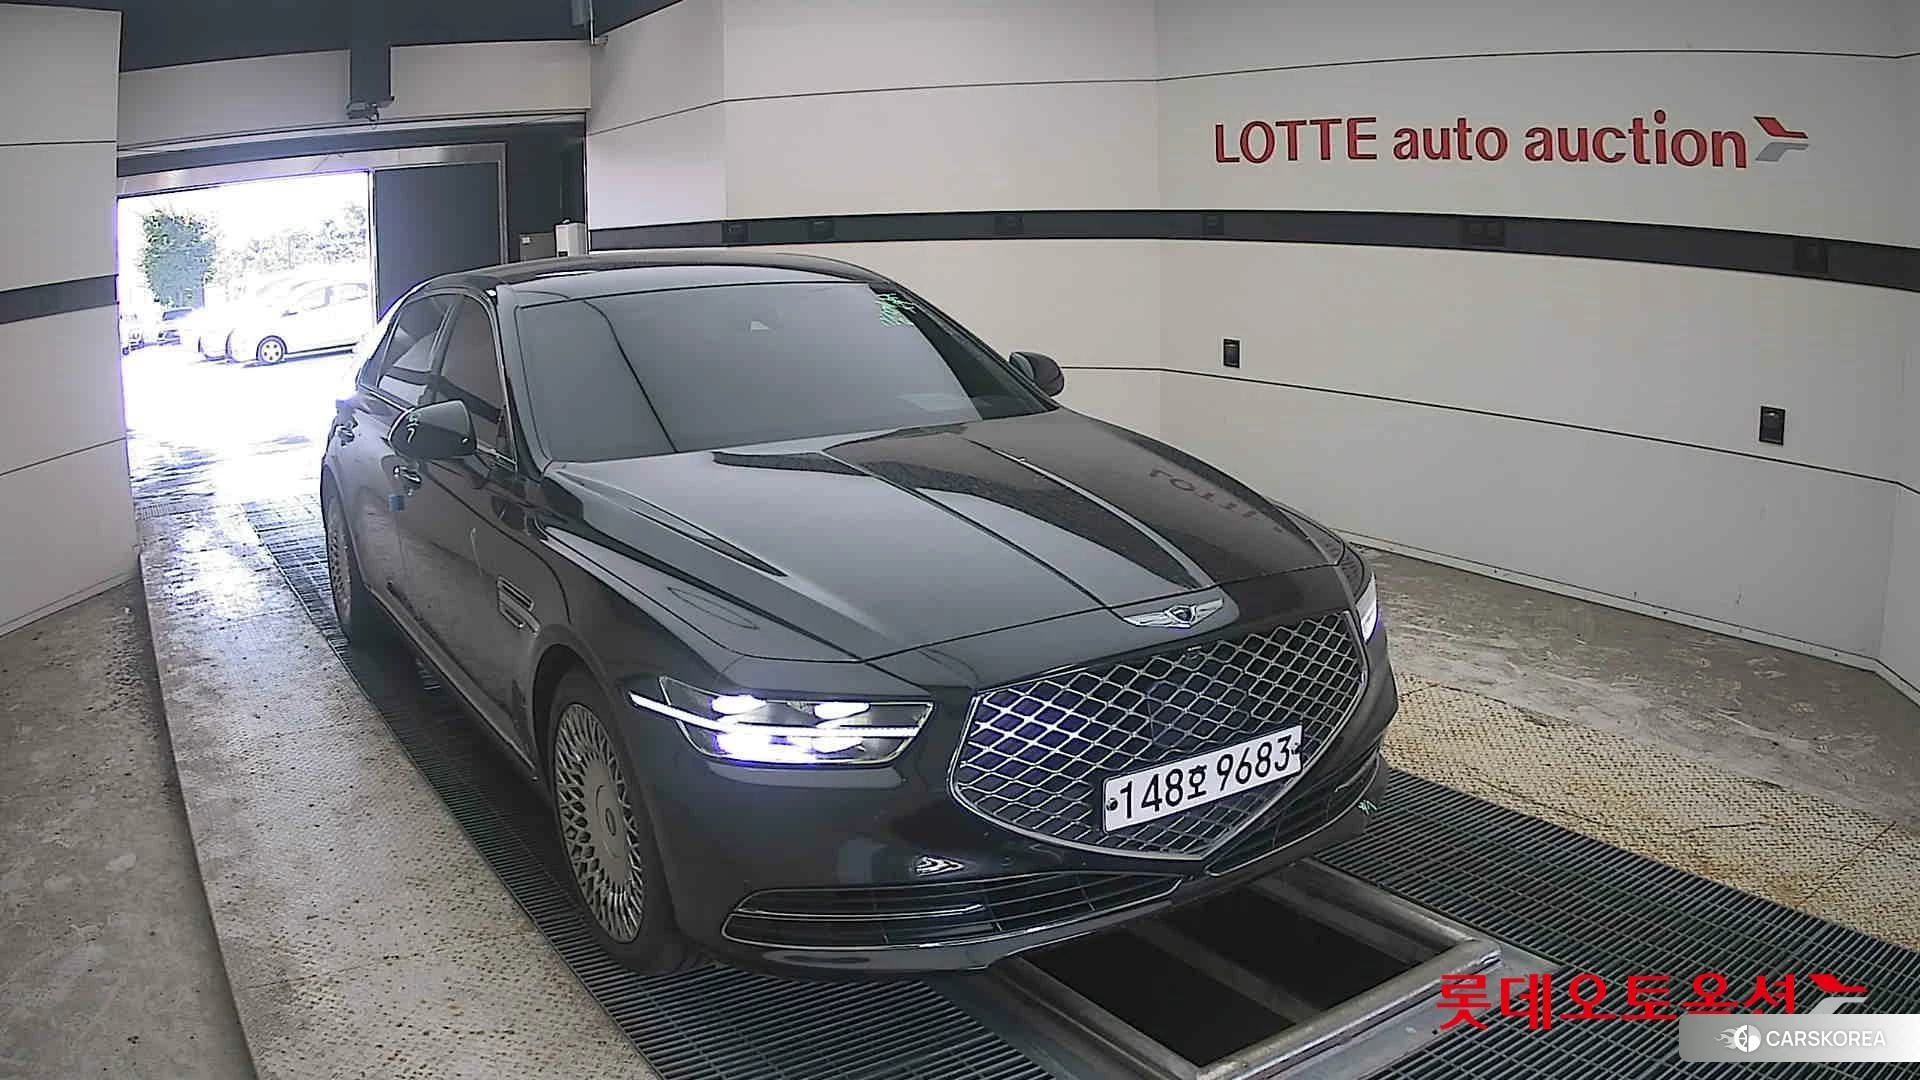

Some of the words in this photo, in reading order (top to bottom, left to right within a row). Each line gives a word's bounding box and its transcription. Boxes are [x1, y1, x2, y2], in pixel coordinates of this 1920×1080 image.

[1215, 117, 1377, 163] LOTTE
[1393, 117, 1509, 161] auto
[1523, 110, 1748, 168] auction
[1119, 763, 1208, 819] 148호
[1215, 734, 1292, 792] 9683
